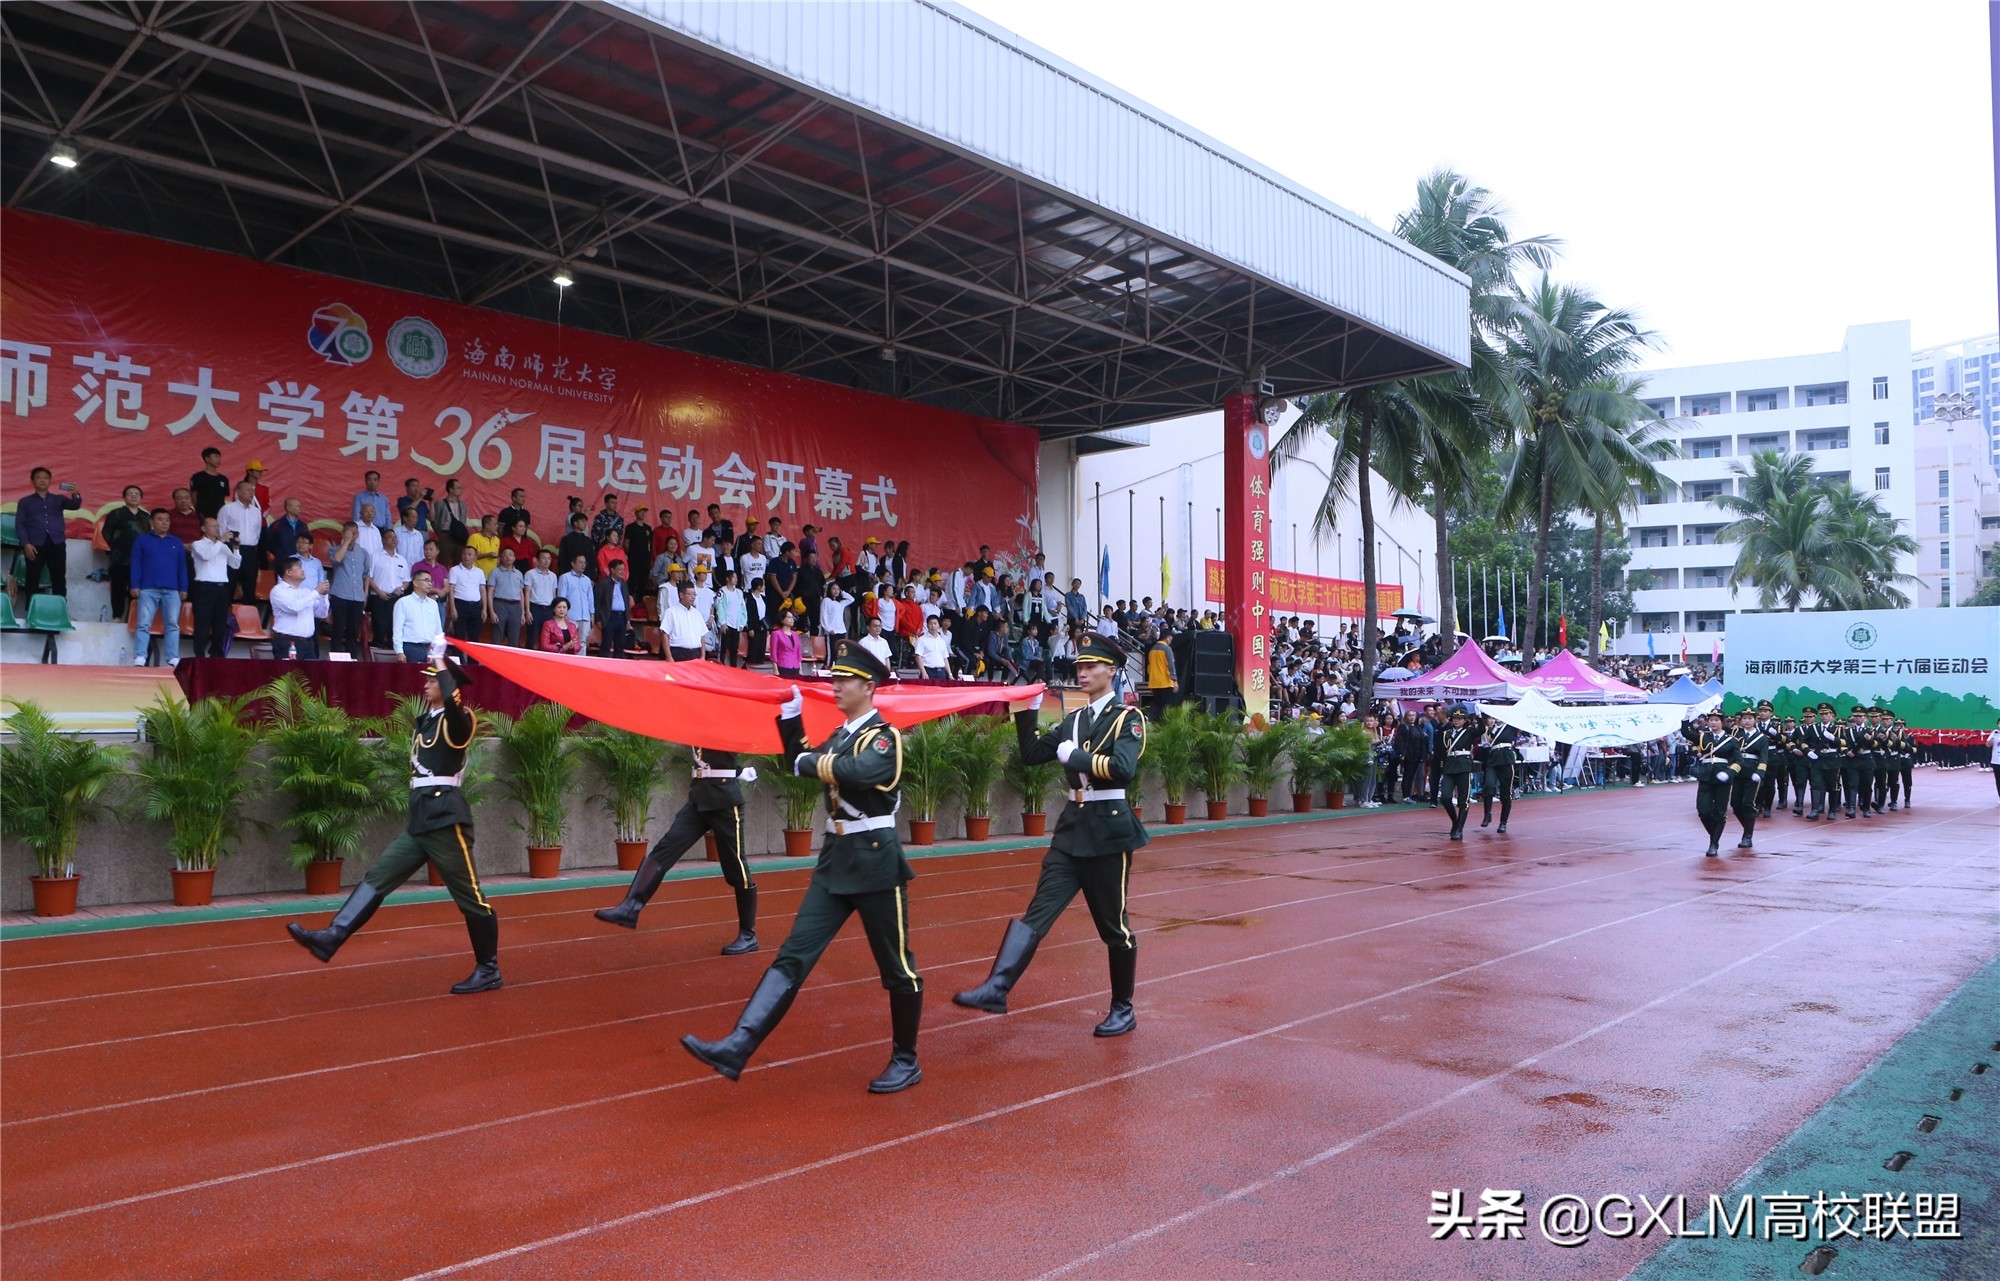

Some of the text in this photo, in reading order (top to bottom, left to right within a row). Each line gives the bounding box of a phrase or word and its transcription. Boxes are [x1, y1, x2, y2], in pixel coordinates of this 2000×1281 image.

[464, 337, 616, 390] 海南师范大学
[463, 368, 614, 404] HAINAN NORMAL UNIVERSITY
[1249, 474, 1266, 692] 体育强则中国强
[1745, 658, 1988, 675] 海南师范大学第三十六届运动会
[1400, 686, 1434, 696] 我的未来
